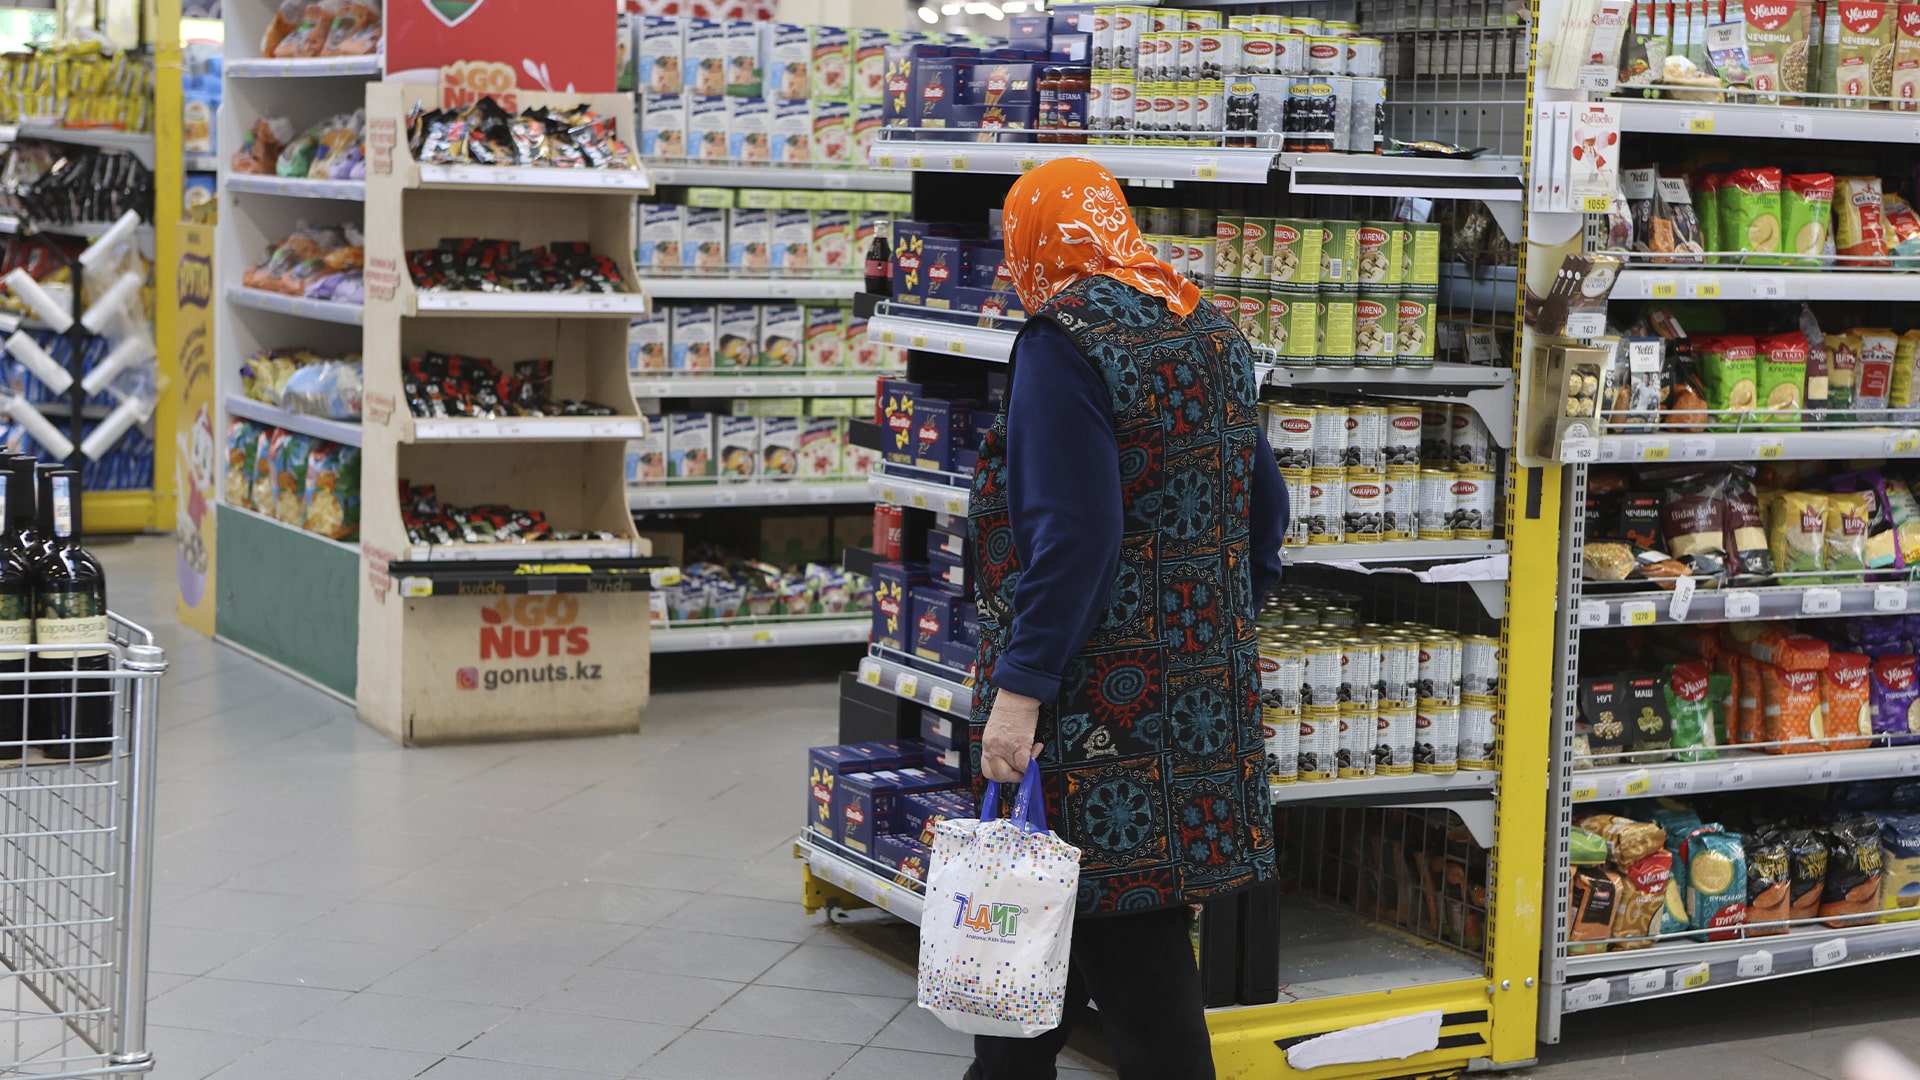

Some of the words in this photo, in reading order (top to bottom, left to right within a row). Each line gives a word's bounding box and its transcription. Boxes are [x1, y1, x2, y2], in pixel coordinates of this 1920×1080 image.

[1749, 2, 1788, 19] Увелка
[1845, 8, 1879, 22] Увелка
[1591, 14, 1625, 26] Raffaello
[1903, 12, 1920, 27] Уве
[1747, 33, 1791, 43] ЧЕЧЕВИЦА
[1842, 36, 1880, 46] ЧЕЧЕВИЦА
[467, 67, 512, 92] GO
[1594, 78, 1609, 87] 1629
[1758, 79, 1766, 90] 5
[1580, 112, 1613, 124] Raffaello
[1587, 199, 1606, 210] 1055
[1357, 304, 1382, 315] KARENA
[1583, 326, 1597, 334] 1631
[1635, 344, 1654, 355] Yelli
[1625, 509, 1658, 517] ЧЕЧЕВИЦА
[513, 594, 580, 627] GO
[1635, 612, 1649, 621] 1270
[480, 626, 590, 660] NUTS
[484, 660, 603, 691] gonuts.kz
[1596, 694, 1612, 703] НУТ
[1634, 689, 1653, 698] МАШ
[965, 933, 987, 942] Anatomic
[1000, 937, 1016, 945] Shoes
